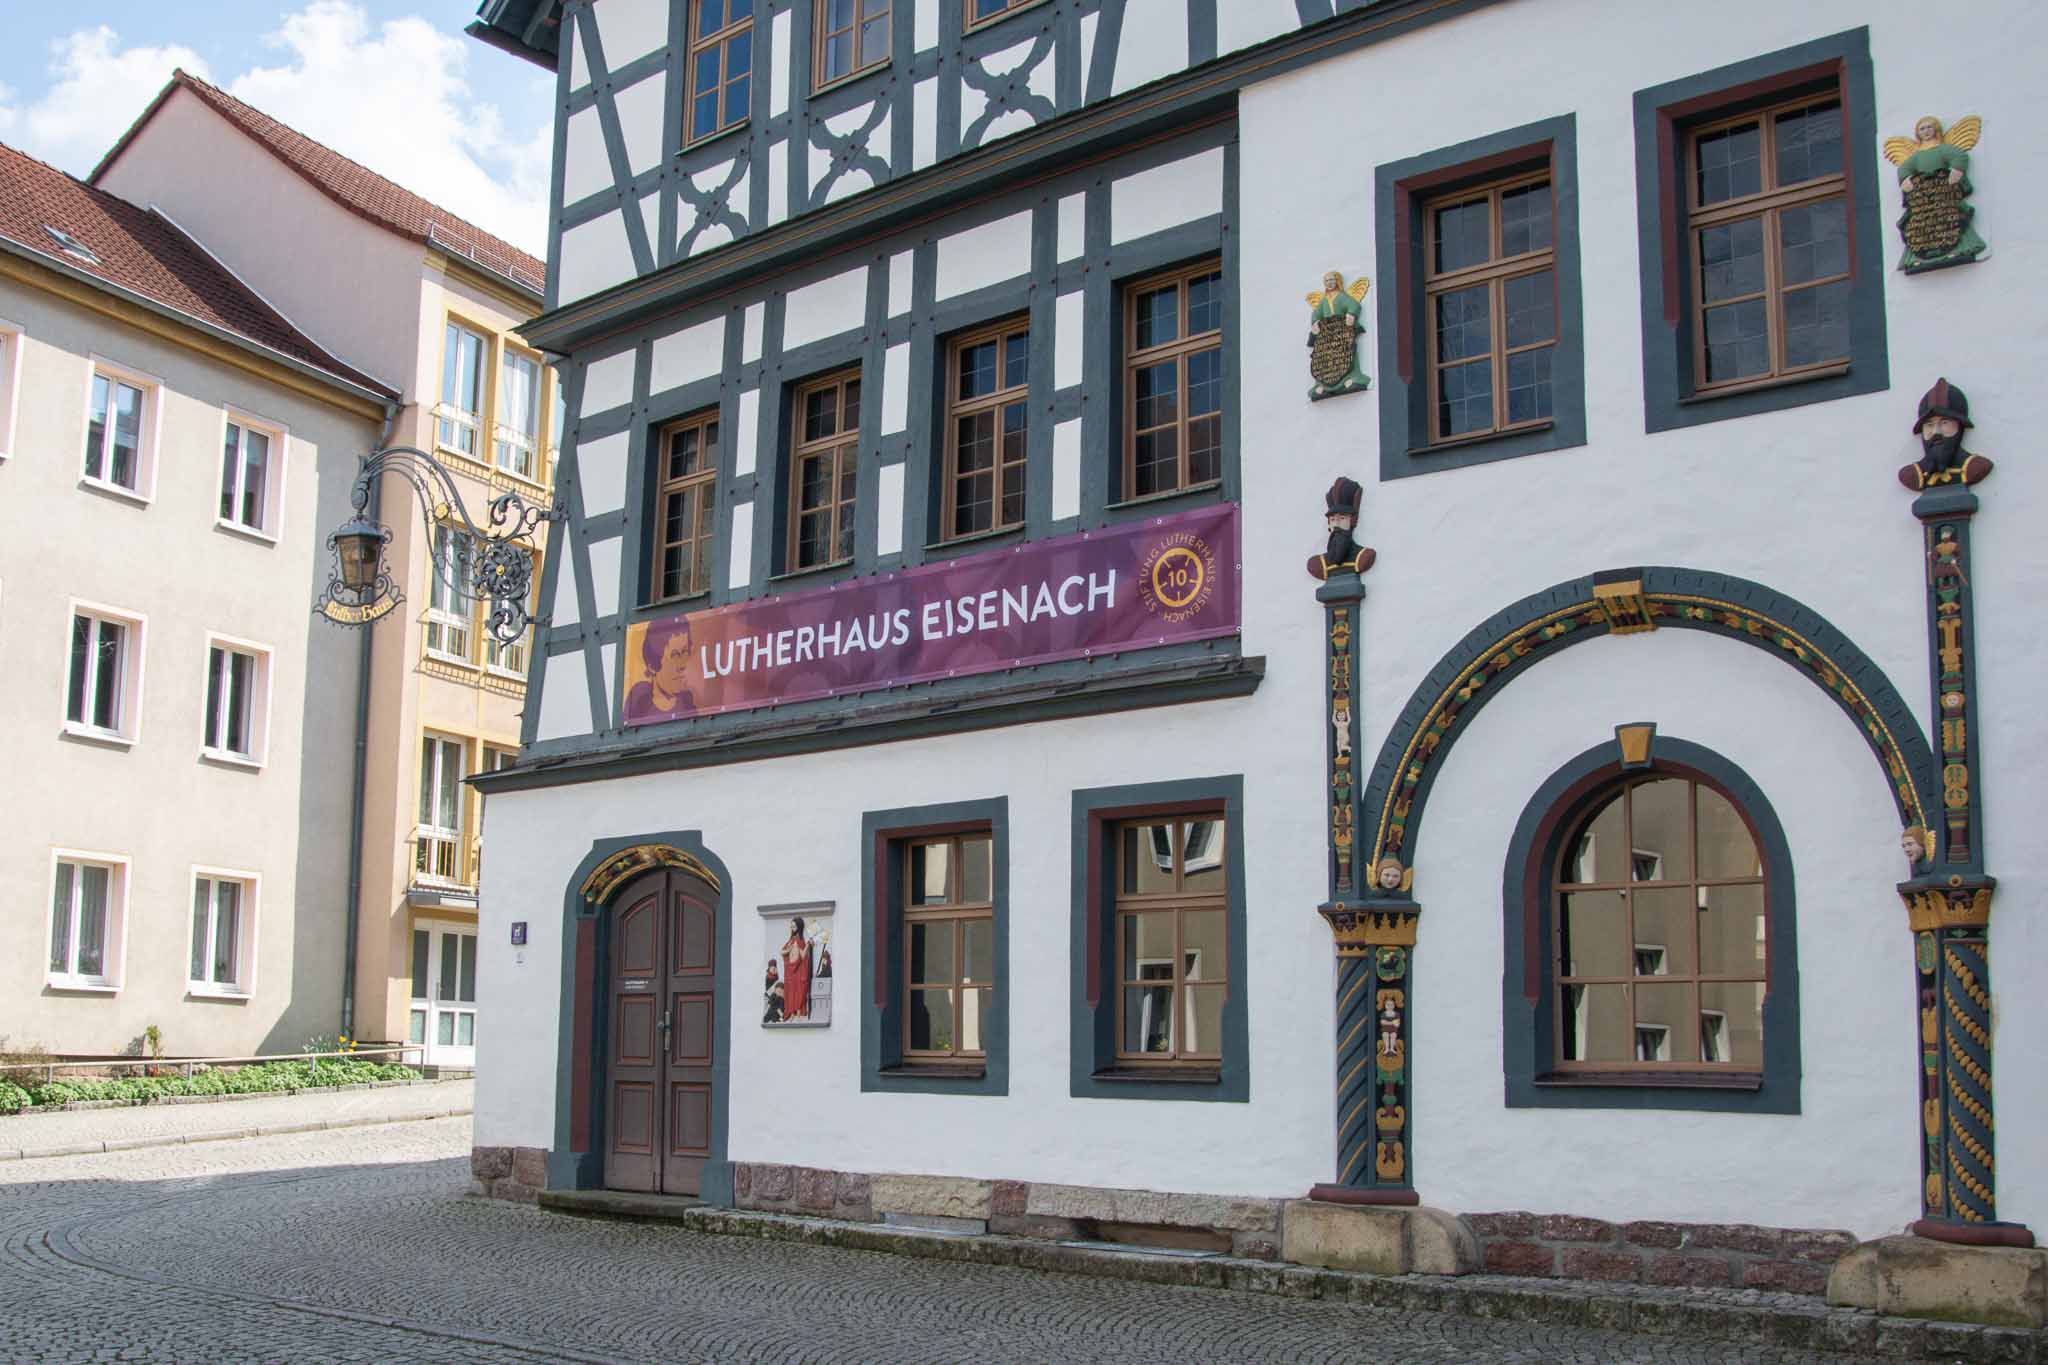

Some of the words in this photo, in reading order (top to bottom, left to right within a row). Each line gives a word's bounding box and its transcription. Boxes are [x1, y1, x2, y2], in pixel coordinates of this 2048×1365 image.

[1139, 548, 1159, 612] STIFTUNG
[1160, 532, 1216, 583] LUTHERHAUS
[1168, 569, 1187, 588] 10
[700, 608, 911, 679] LUTHERHAUS
[922, 568, 1116, 641] EISENACH
[1163, 586, 1212, 623] EISENACH
